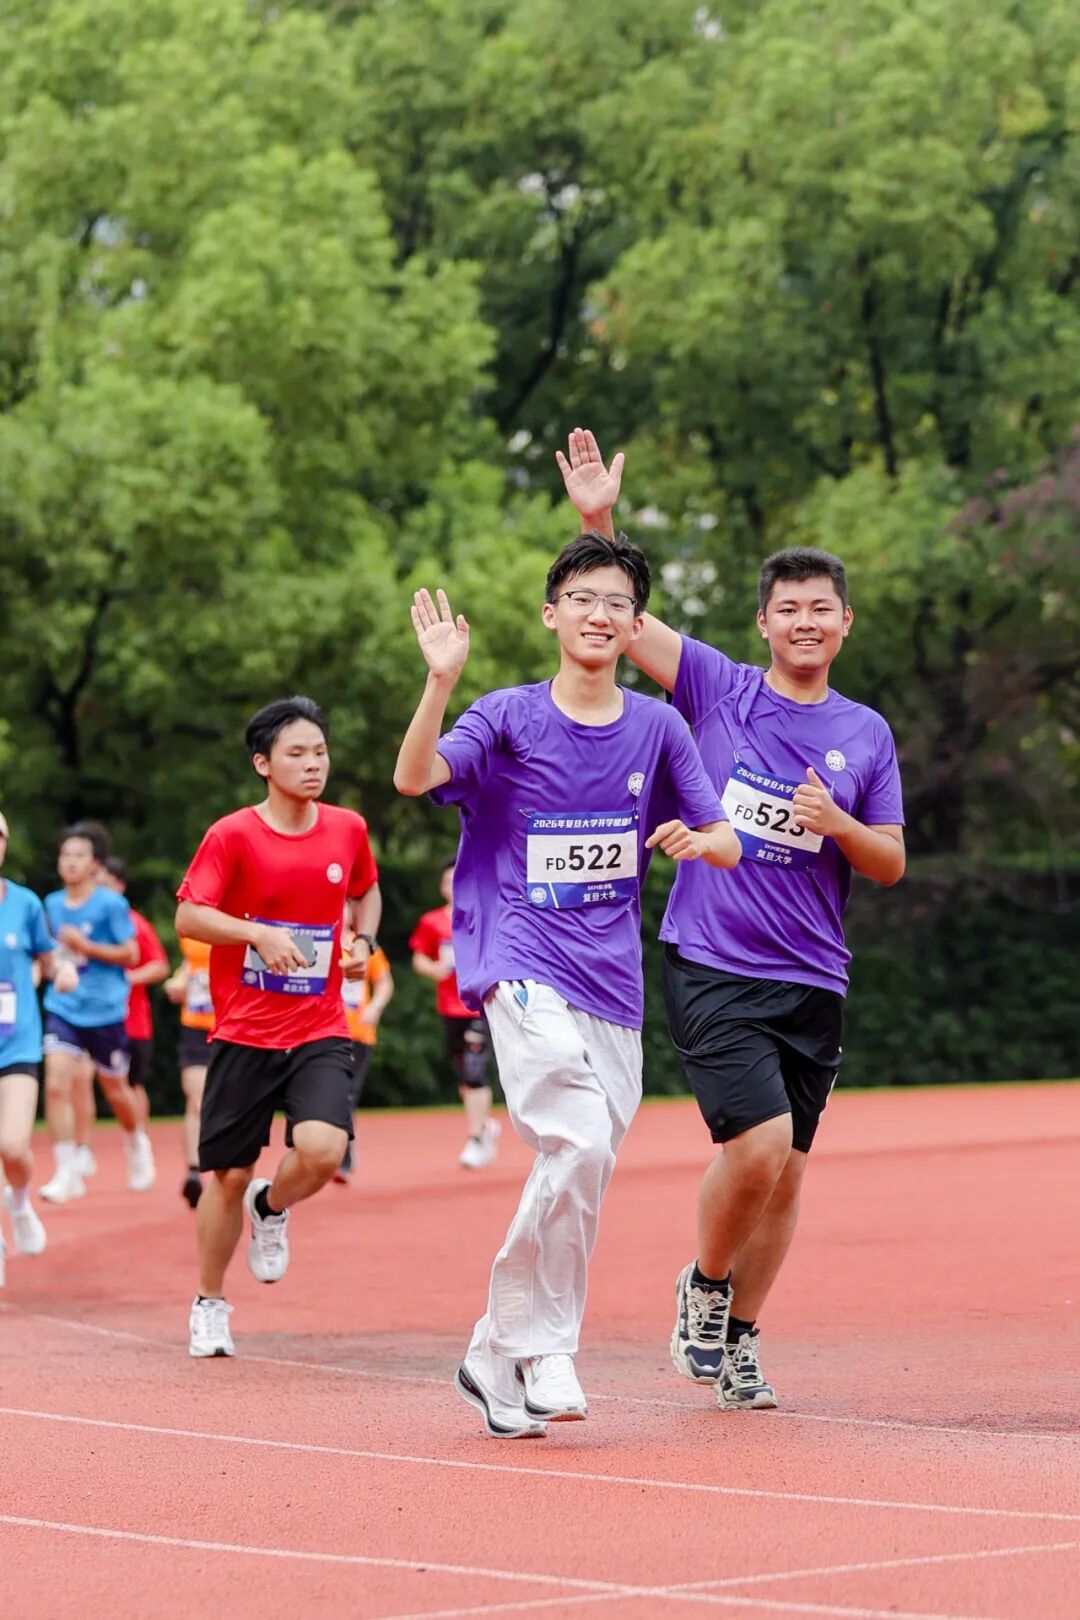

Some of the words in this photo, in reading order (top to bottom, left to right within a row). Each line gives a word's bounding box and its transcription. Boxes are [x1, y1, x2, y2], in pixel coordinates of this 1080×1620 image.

[546, 843, 622, 871] FD522
[756, 848, 793, 865] 复旦大学
[582, 890, 617, 903] 复旦大学
